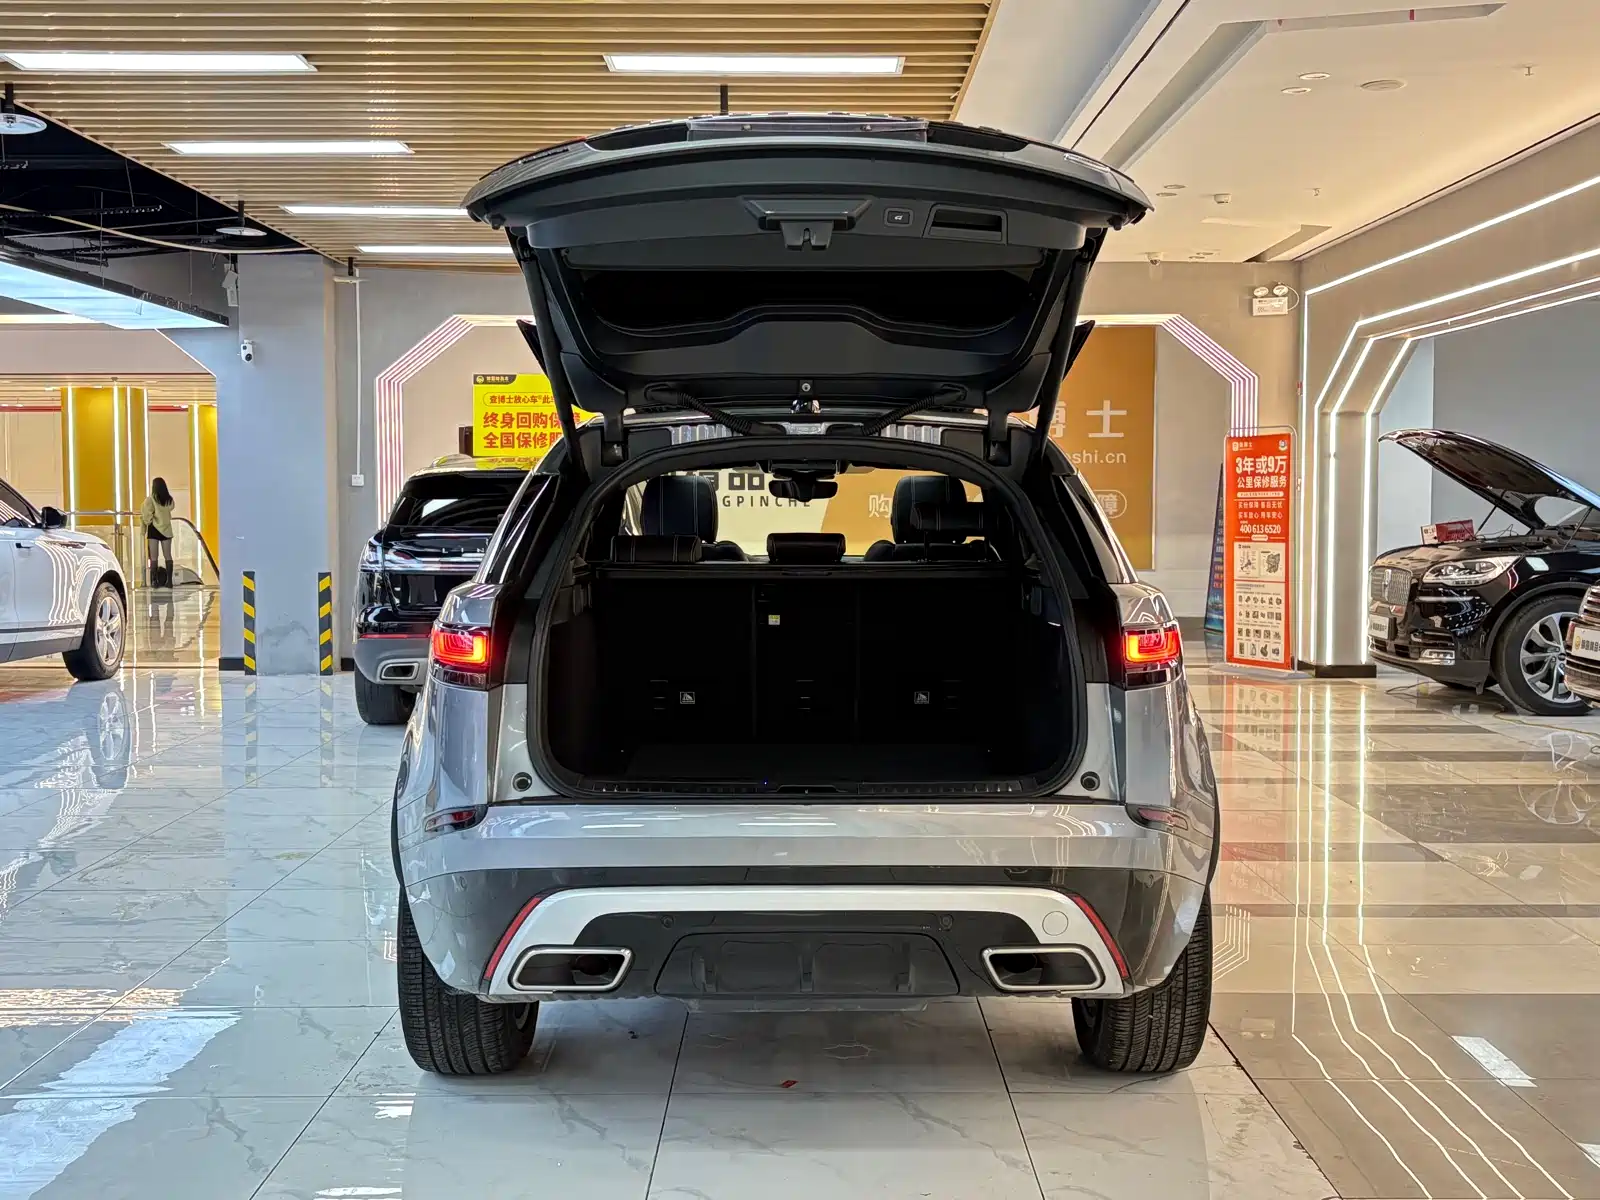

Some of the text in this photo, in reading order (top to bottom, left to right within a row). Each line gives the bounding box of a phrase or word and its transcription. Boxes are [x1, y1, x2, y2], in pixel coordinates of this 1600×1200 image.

[1235, 455, 1287, 475] 3年或9万
[1236, 476, 1287, 488] 公里保修服务
[1239, 524, 1281, 534] 400 613 6520
